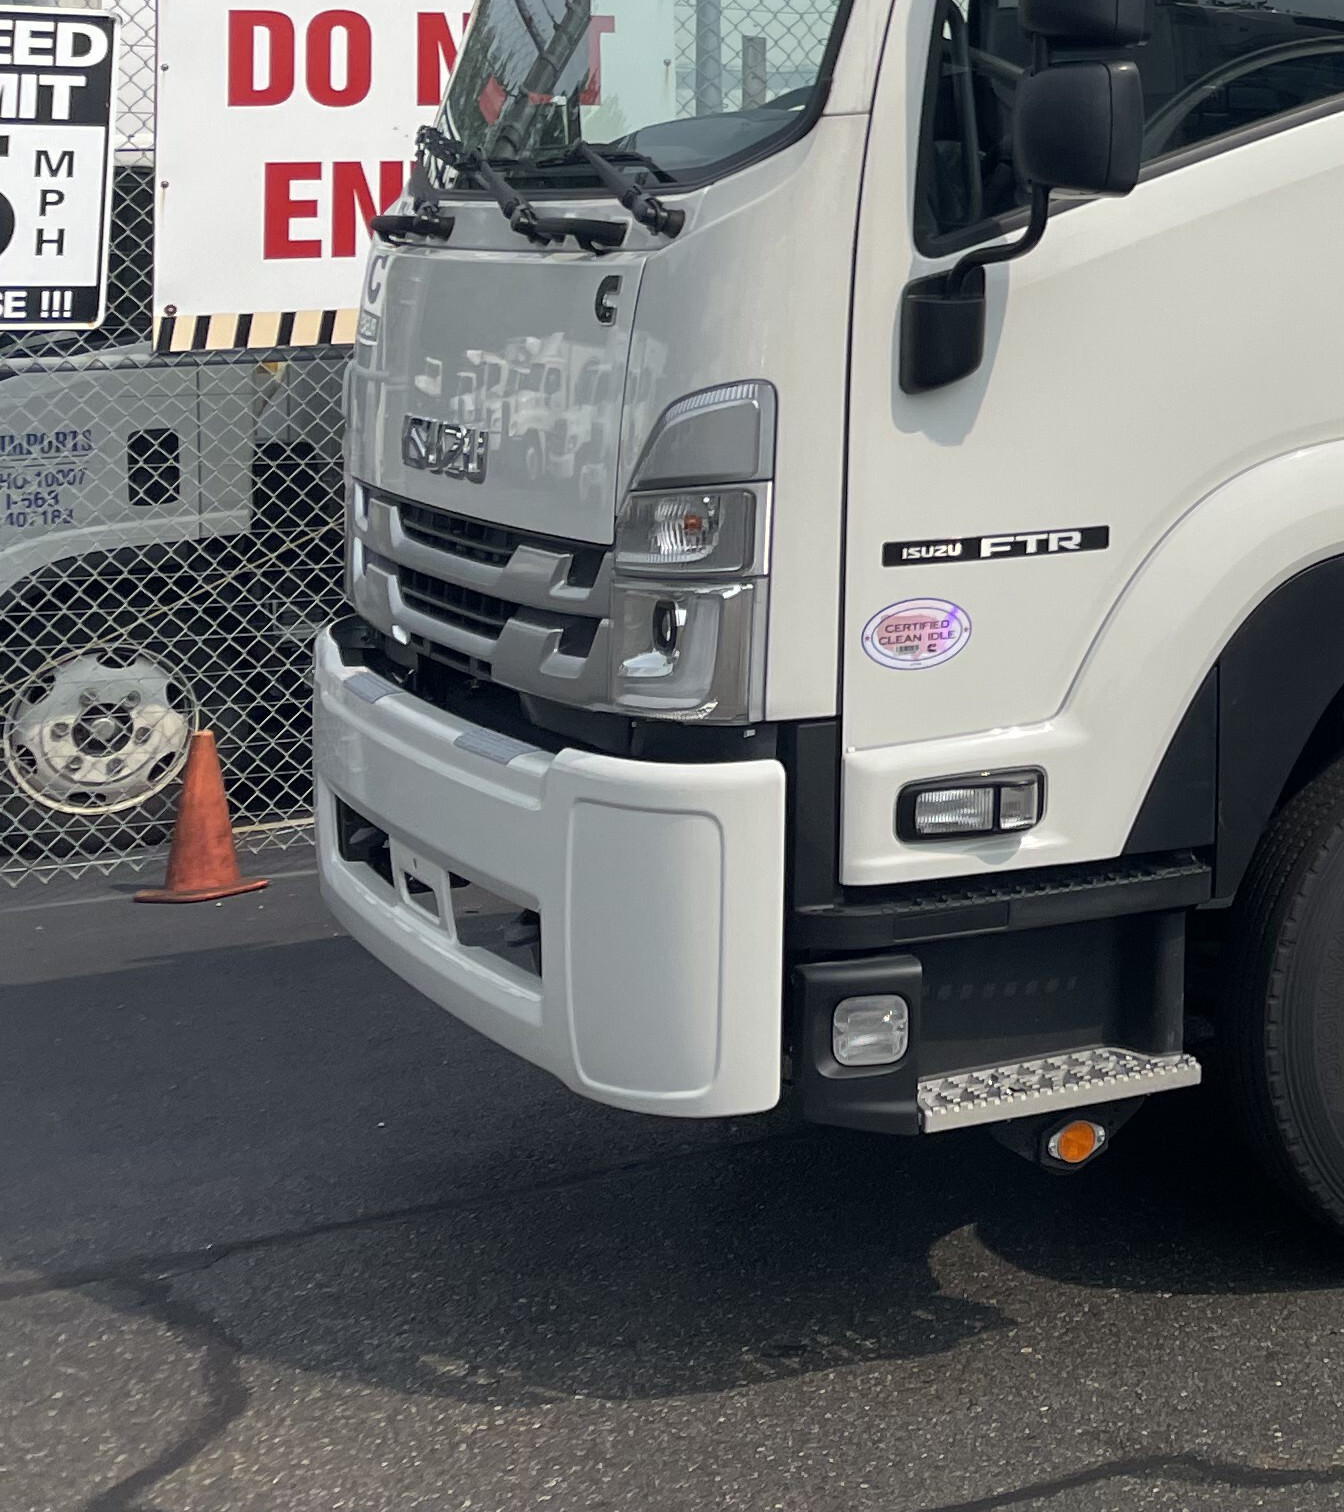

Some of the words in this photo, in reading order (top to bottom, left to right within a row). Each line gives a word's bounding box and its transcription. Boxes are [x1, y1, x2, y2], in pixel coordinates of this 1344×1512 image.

[227, 9, 373, 108] DO
[901, 541, 963, 561] ISUZU
[979, 530, 1082, 559] FTR
[878, 633, 922, 646] CLEAN
[926, 629, 956, 642] IDLE
[885, 619, 950, 634] CERTIFIED
